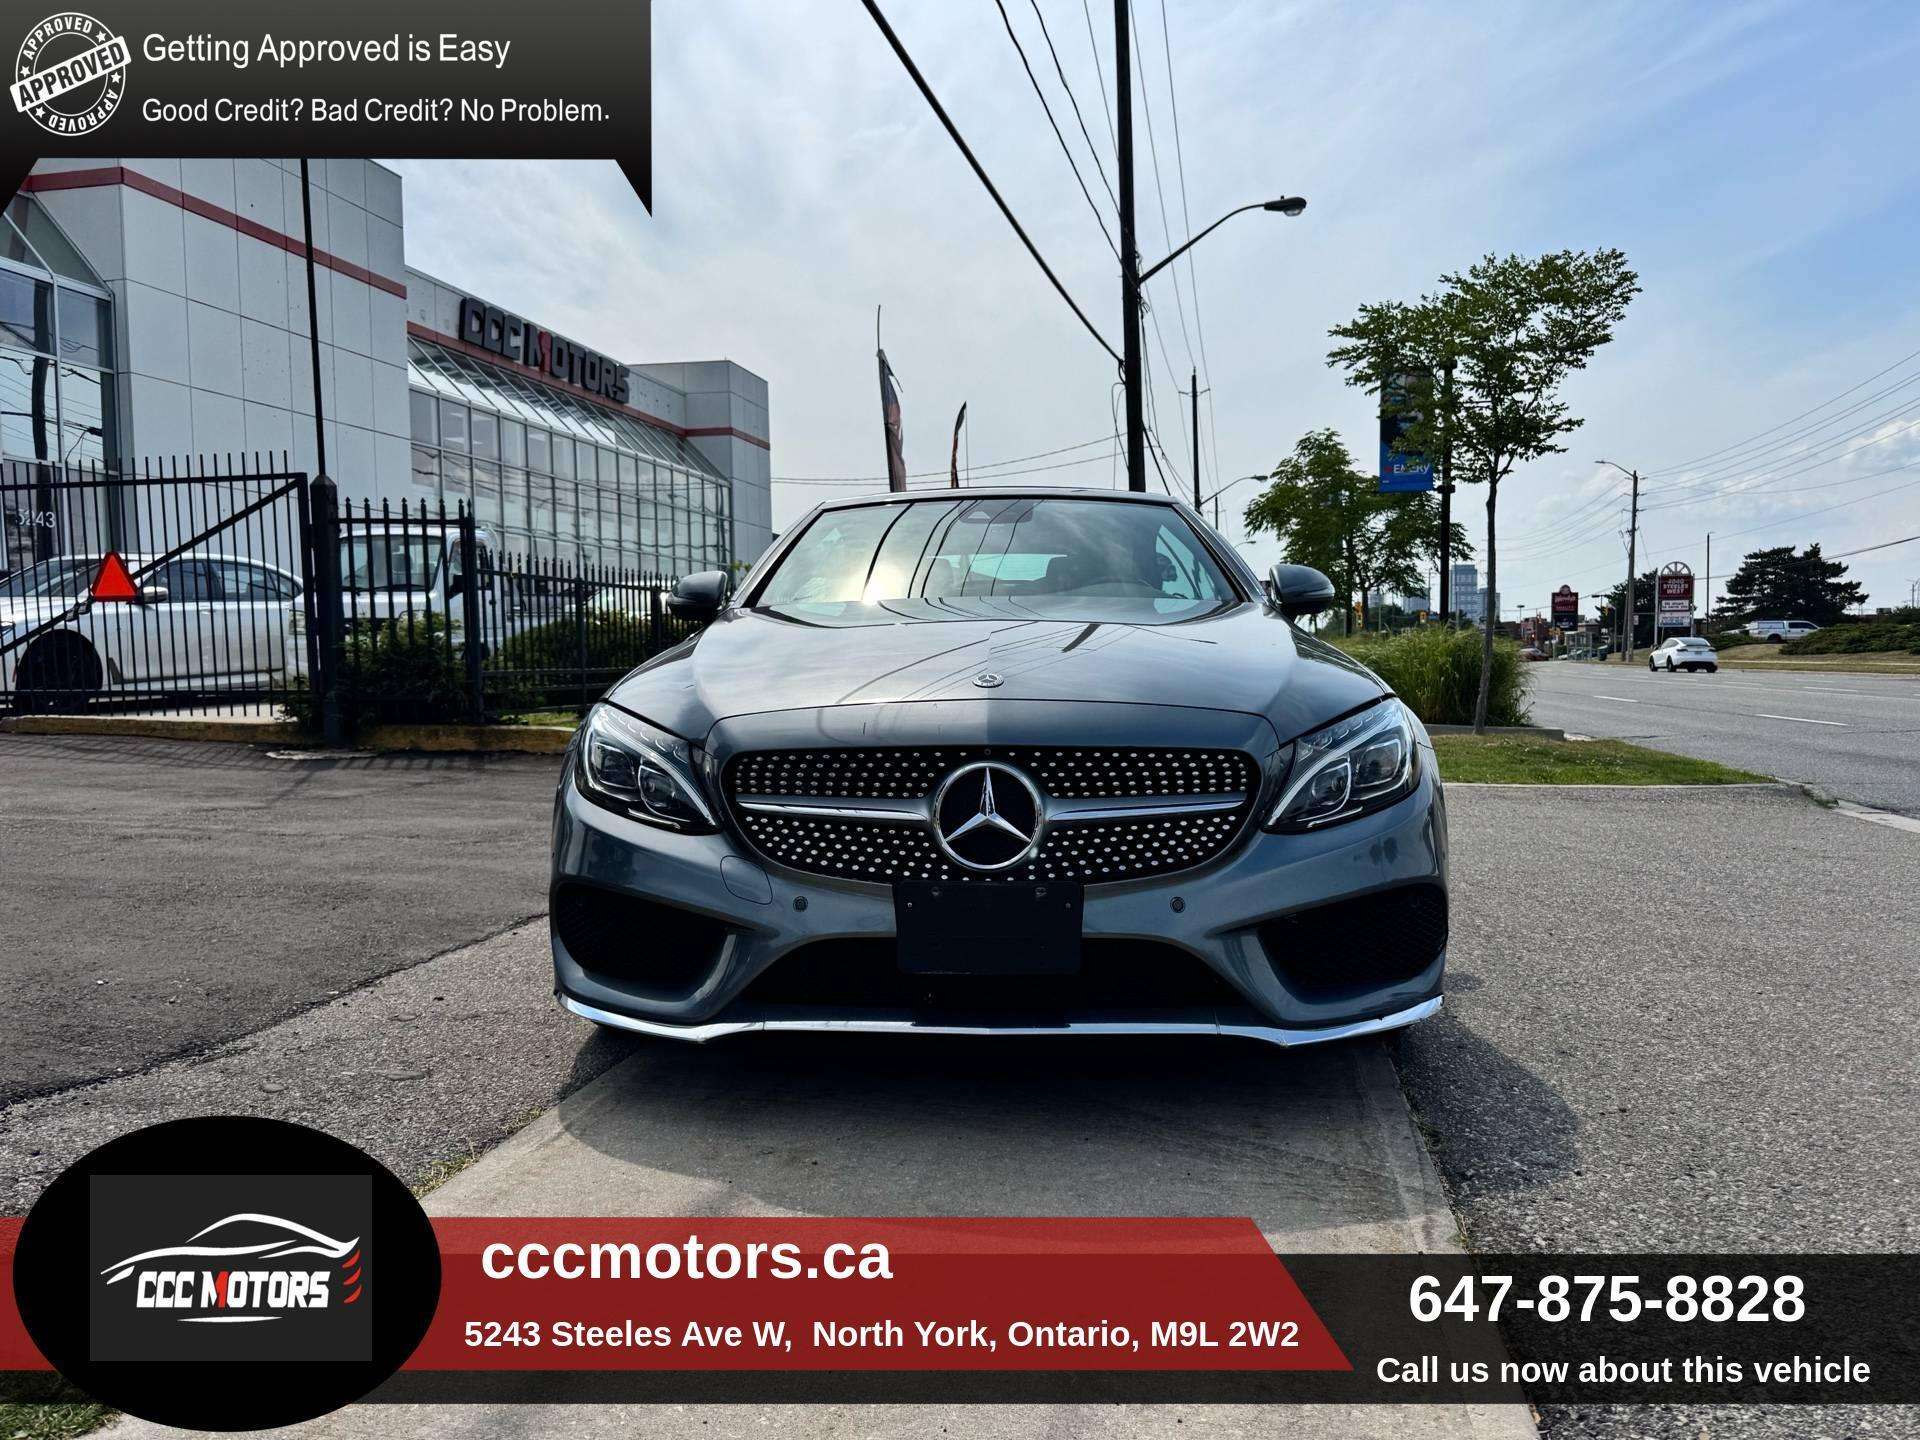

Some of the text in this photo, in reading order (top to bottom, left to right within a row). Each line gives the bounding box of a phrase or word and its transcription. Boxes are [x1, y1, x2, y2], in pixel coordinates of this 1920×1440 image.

[458, 297, 630, 405] CCC MOTORS
[16, 508, 56, 529] 5243
